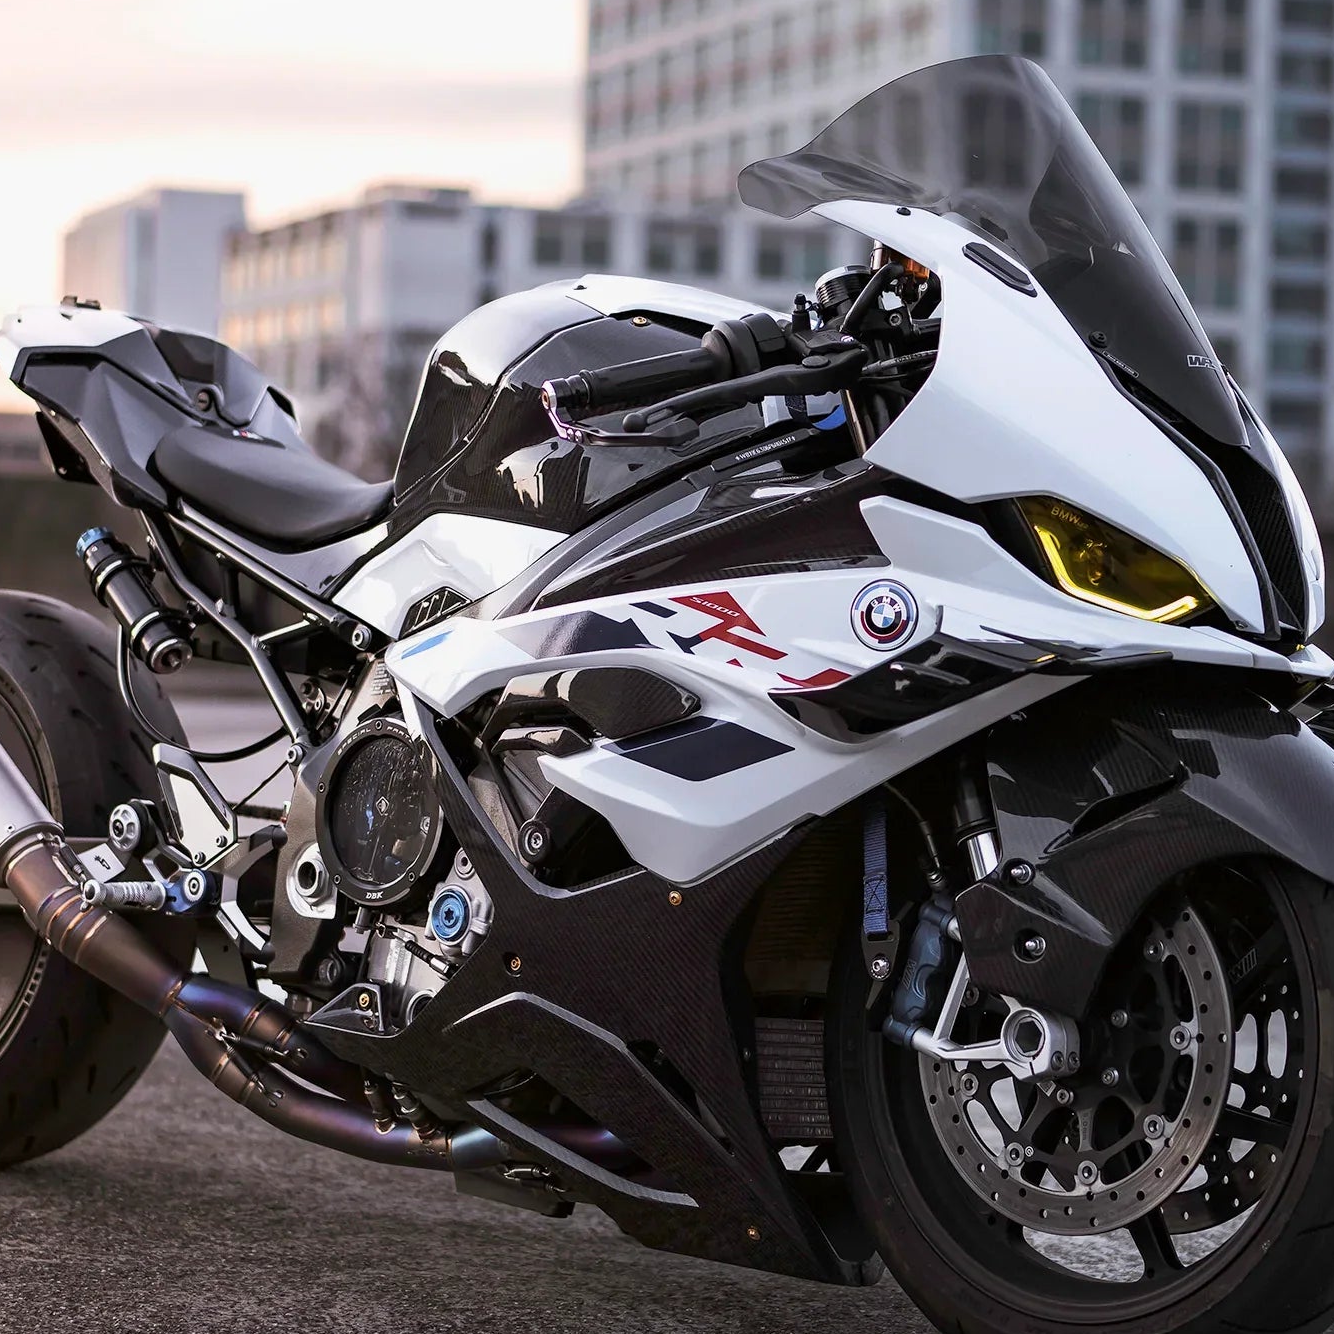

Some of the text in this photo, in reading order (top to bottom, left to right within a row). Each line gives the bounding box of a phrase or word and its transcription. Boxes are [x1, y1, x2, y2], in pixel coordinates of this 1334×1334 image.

[1051, 507, 1081, 524] BMW
[689, 597, 741, 617] S1000
[870, 596, 902, 613] BMW
[337, 727, 371, 756] SPECIAL
[365, 890, 384, 900] DBK
